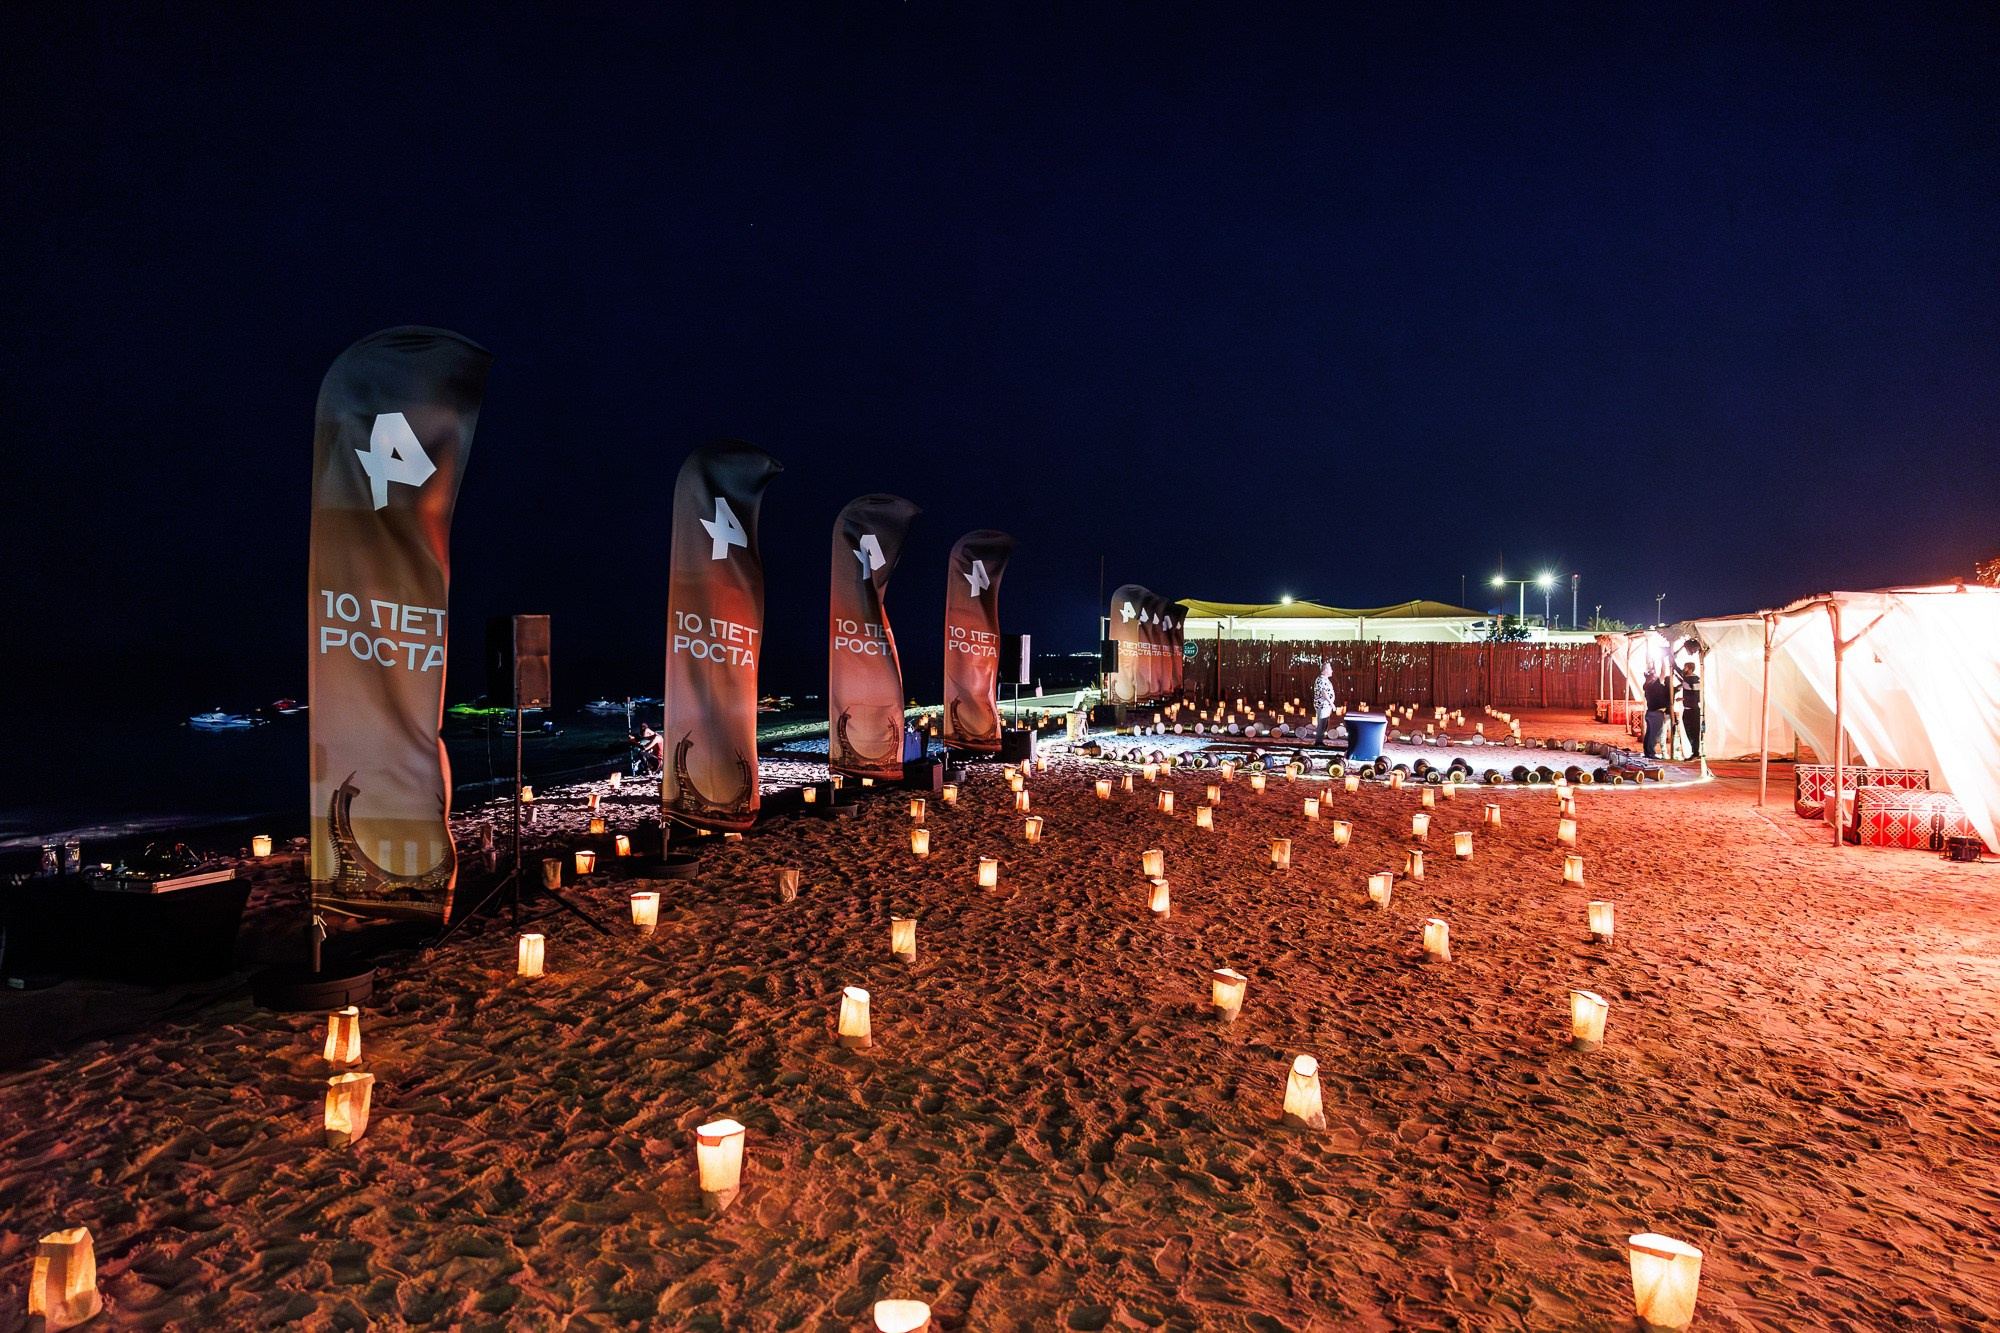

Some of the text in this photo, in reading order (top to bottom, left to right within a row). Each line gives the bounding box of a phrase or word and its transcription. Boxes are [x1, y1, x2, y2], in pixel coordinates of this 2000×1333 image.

[321, 589, 446, 637] 10 ЛЕТ
[675, 610, 759, 646] 10 ЛЕТ
[835, 618, 889, 639] 10 ЛЕ
[949, 625, 998, 645] 10 ЛЕТ
[320, 626, 444, 672] РОСТА
[673, 634, 755, 671] РОСТА
[948, 639, 997, 658] РОСТА
[1118, 647, 1139, 657] ОСТА
